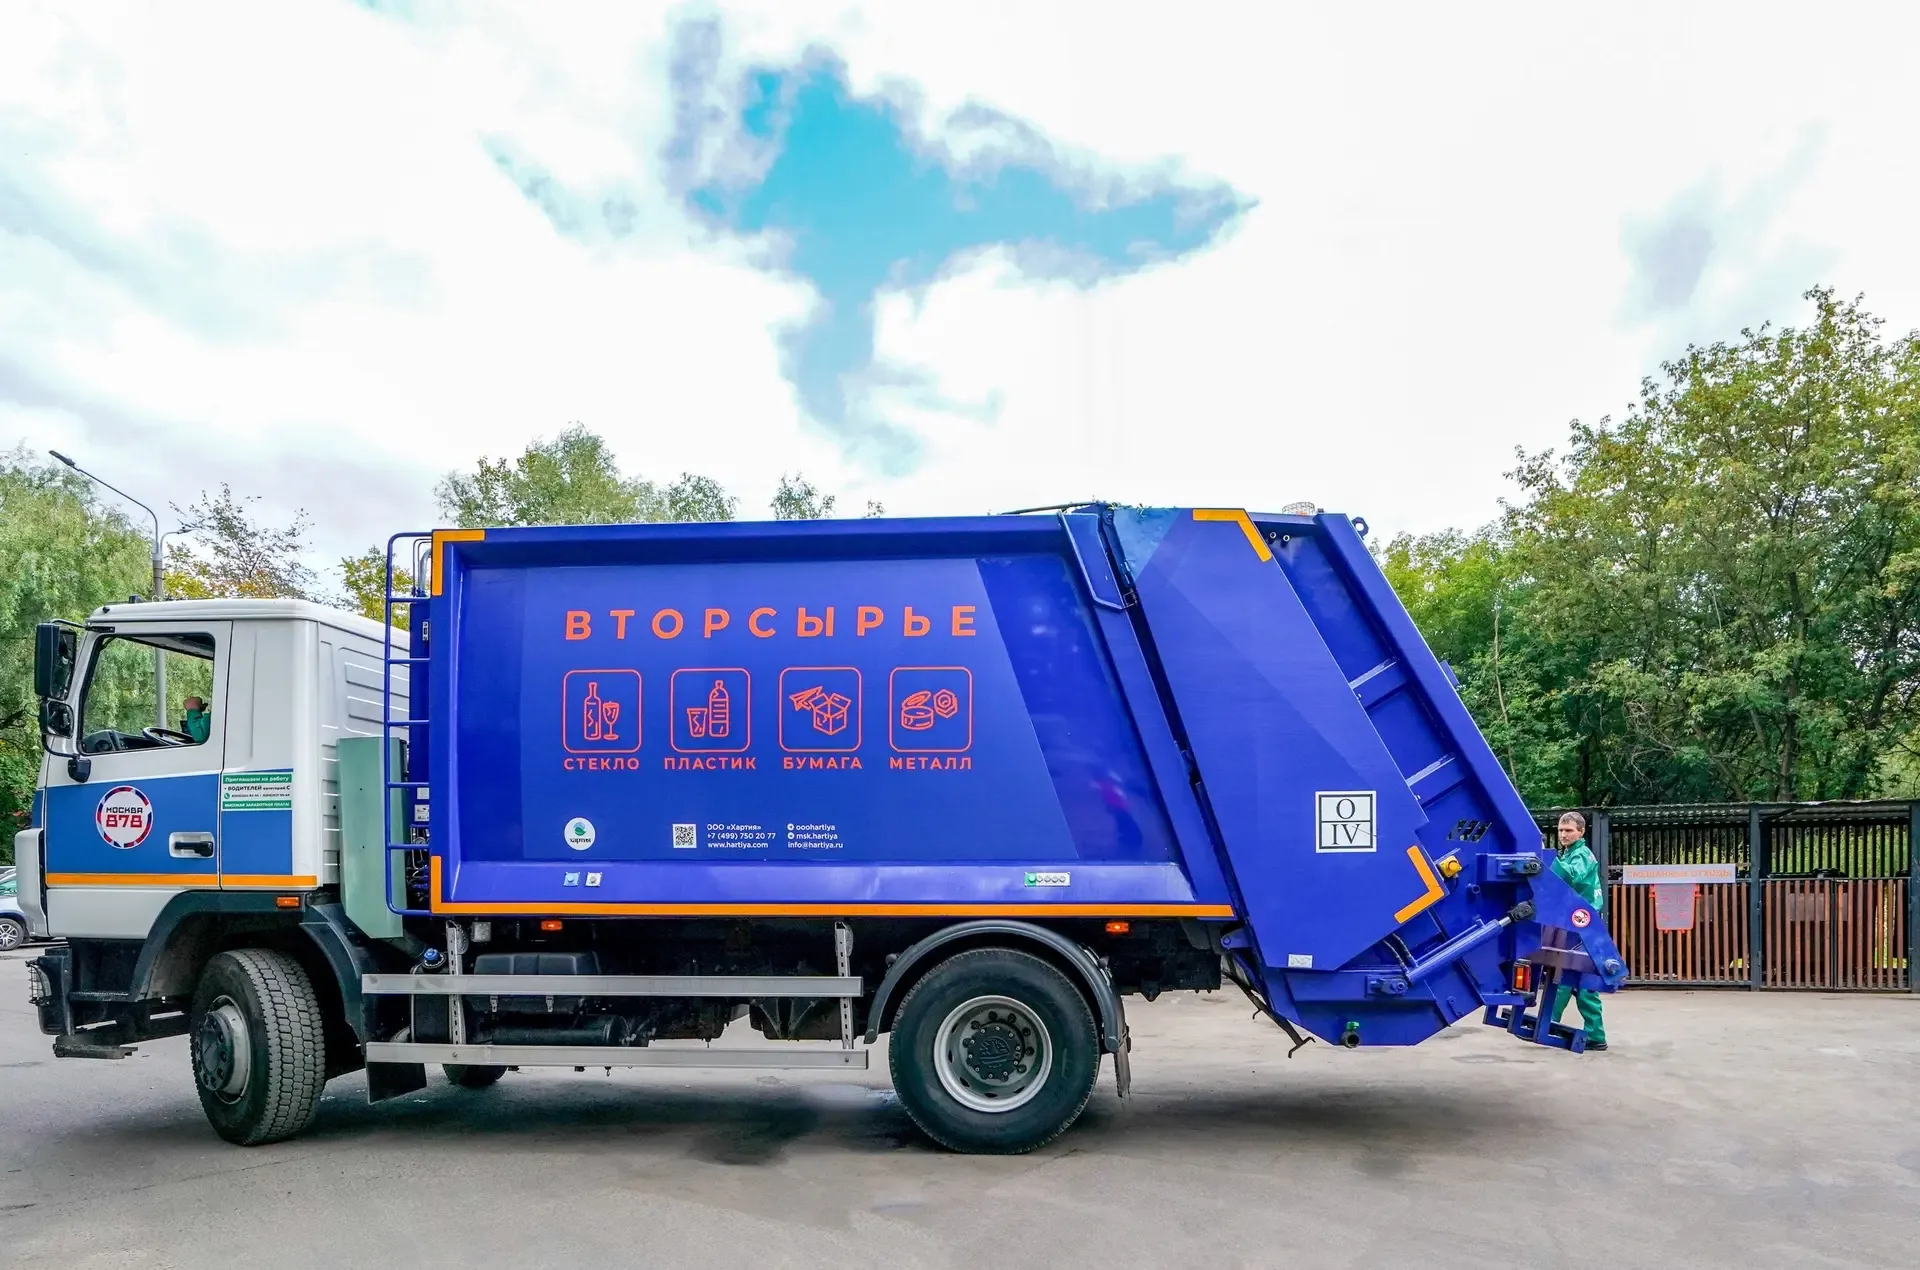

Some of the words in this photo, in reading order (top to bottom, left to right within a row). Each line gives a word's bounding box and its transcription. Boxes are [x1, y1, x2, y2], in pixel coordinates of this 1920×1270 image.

[564, 605, 976, 640] ВТОРСЫРЬЕ
[563, 756, 640, 770] СТЕКЛО
[664, 756, 757, 770] ПЛАСТИК
[783, 755, 863, 770] БУМАГА
[889, 755, 972, 770] МЕТАЛЛ
[106, 806, 143, 814] МОСКВА
[106, 814, 143, 828] 878
[707, 823, 725, 831] ООО
[726, 823, 762, 832] «Хартия»
[796, 823, 836, 832] ooohartiya
[717, 832, 738, 840] (499)
[796, 832, 838, 840] msk.hartiya
[1331, 823, 1361, 845] IV
[707, 841, 769, 849] www.hartiya.com
[788, 841, 843, 849] info@hartiya.ru
